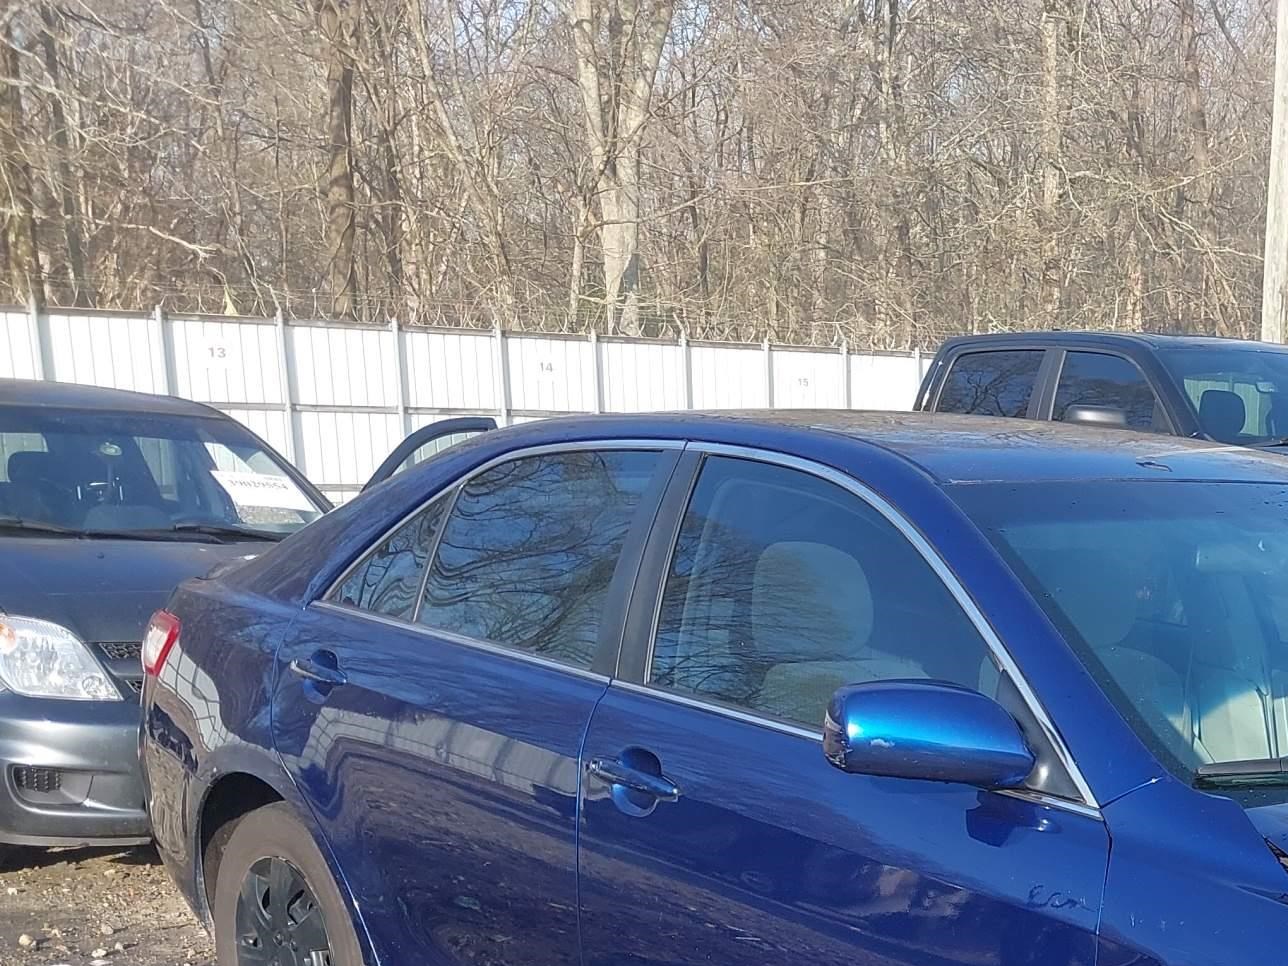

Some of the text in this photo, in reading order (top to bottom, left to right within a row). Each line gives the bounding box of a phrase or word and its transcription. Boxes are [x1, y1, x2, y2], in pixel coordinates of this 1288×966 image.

[207, 347, 226, 359] 13
[539, 361, 553, 373] 14
[797, 377, 809, 388] 15
